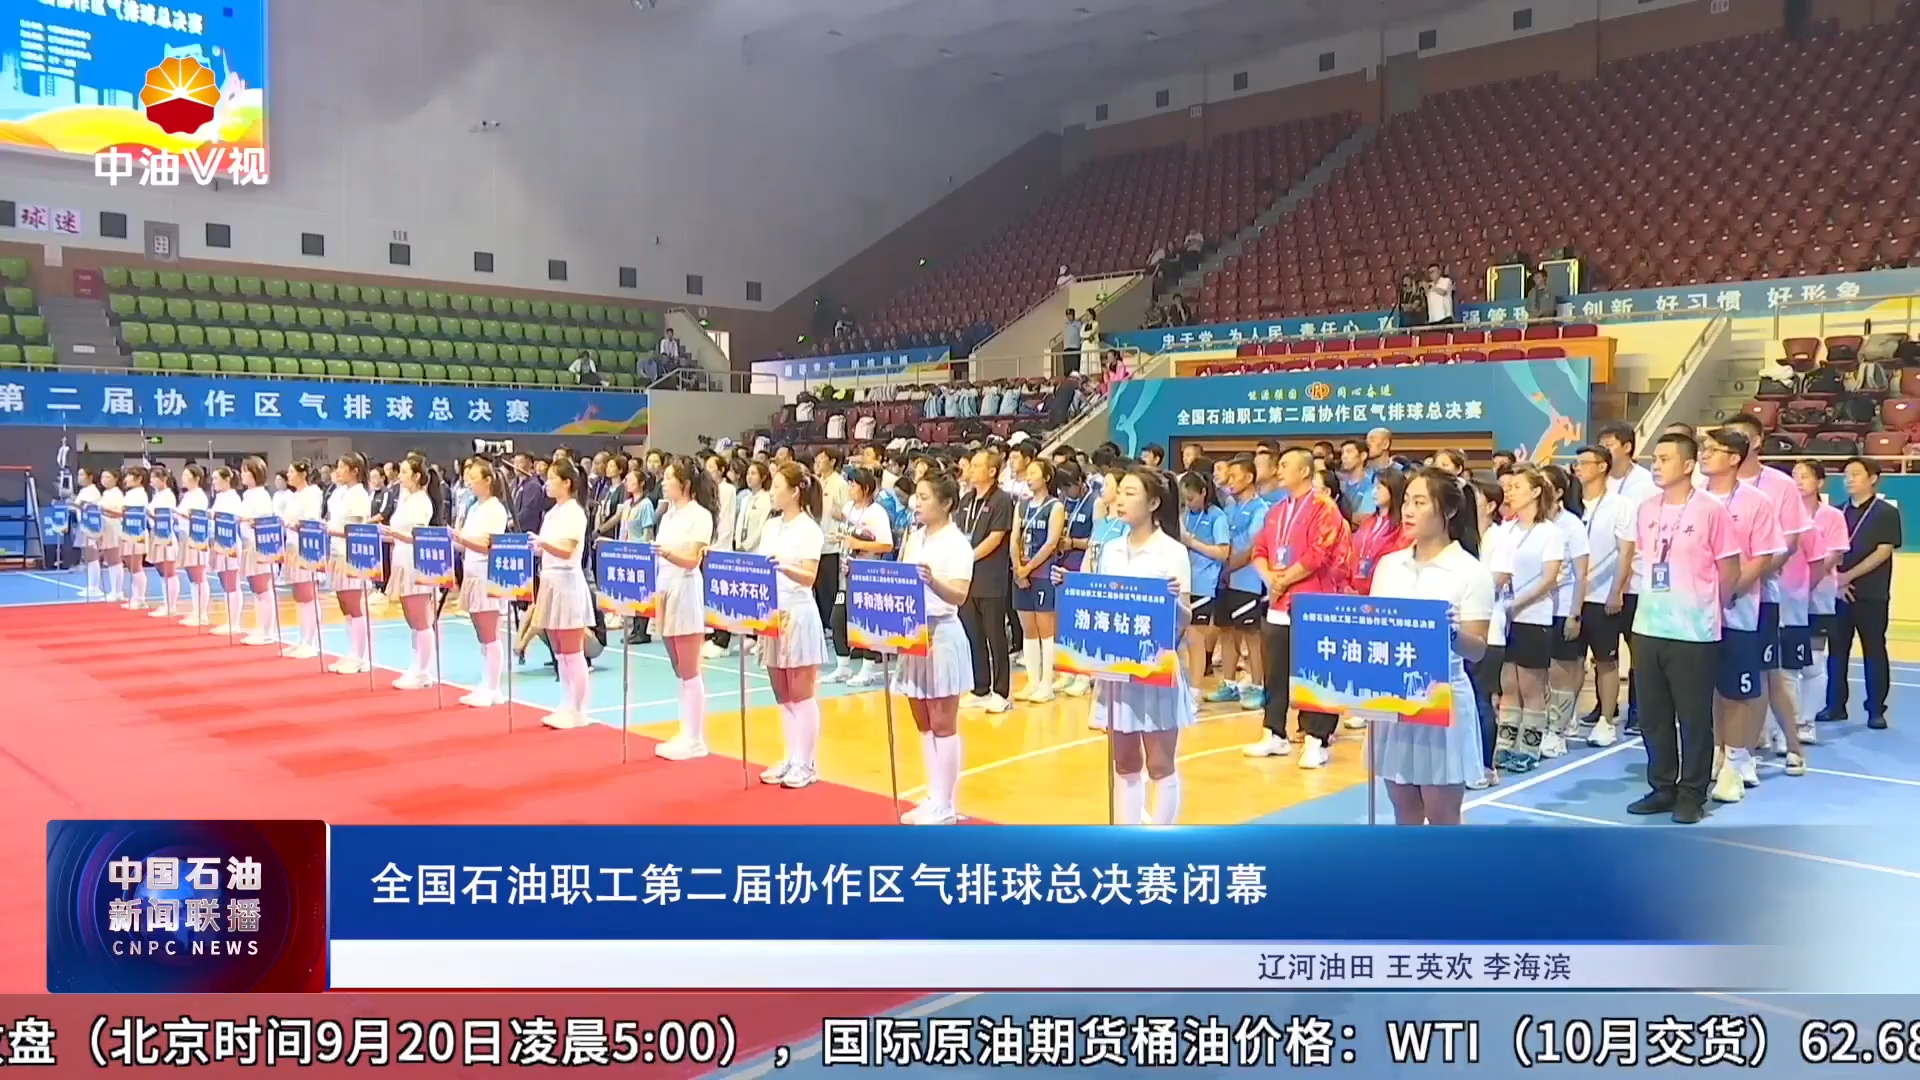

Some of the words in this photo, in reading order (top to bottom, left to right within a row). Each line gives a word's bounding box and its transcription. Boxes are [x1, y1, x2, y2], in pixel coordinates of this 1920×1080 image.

[21, 205, 80, 234] 球迷
[0, 383, 529, 423] 第二届协作区气排球总决赛
[1177, 400, 1482, 426] 全国石油职工第二届协作区气排球总决赛
[709, 577, 770, 601] 乌鲁木齐石化
[1038, 592, 1045, 605] 7
[852, 590, 918, 614] 呼和浩特石化
[1074, 608, 1152, 637] 渤海钻探
[1317, 635, 1418, 668] 中油测井
[1763, 644, 1773, 662] 6
[1740, 673, 1752, 693] 5
